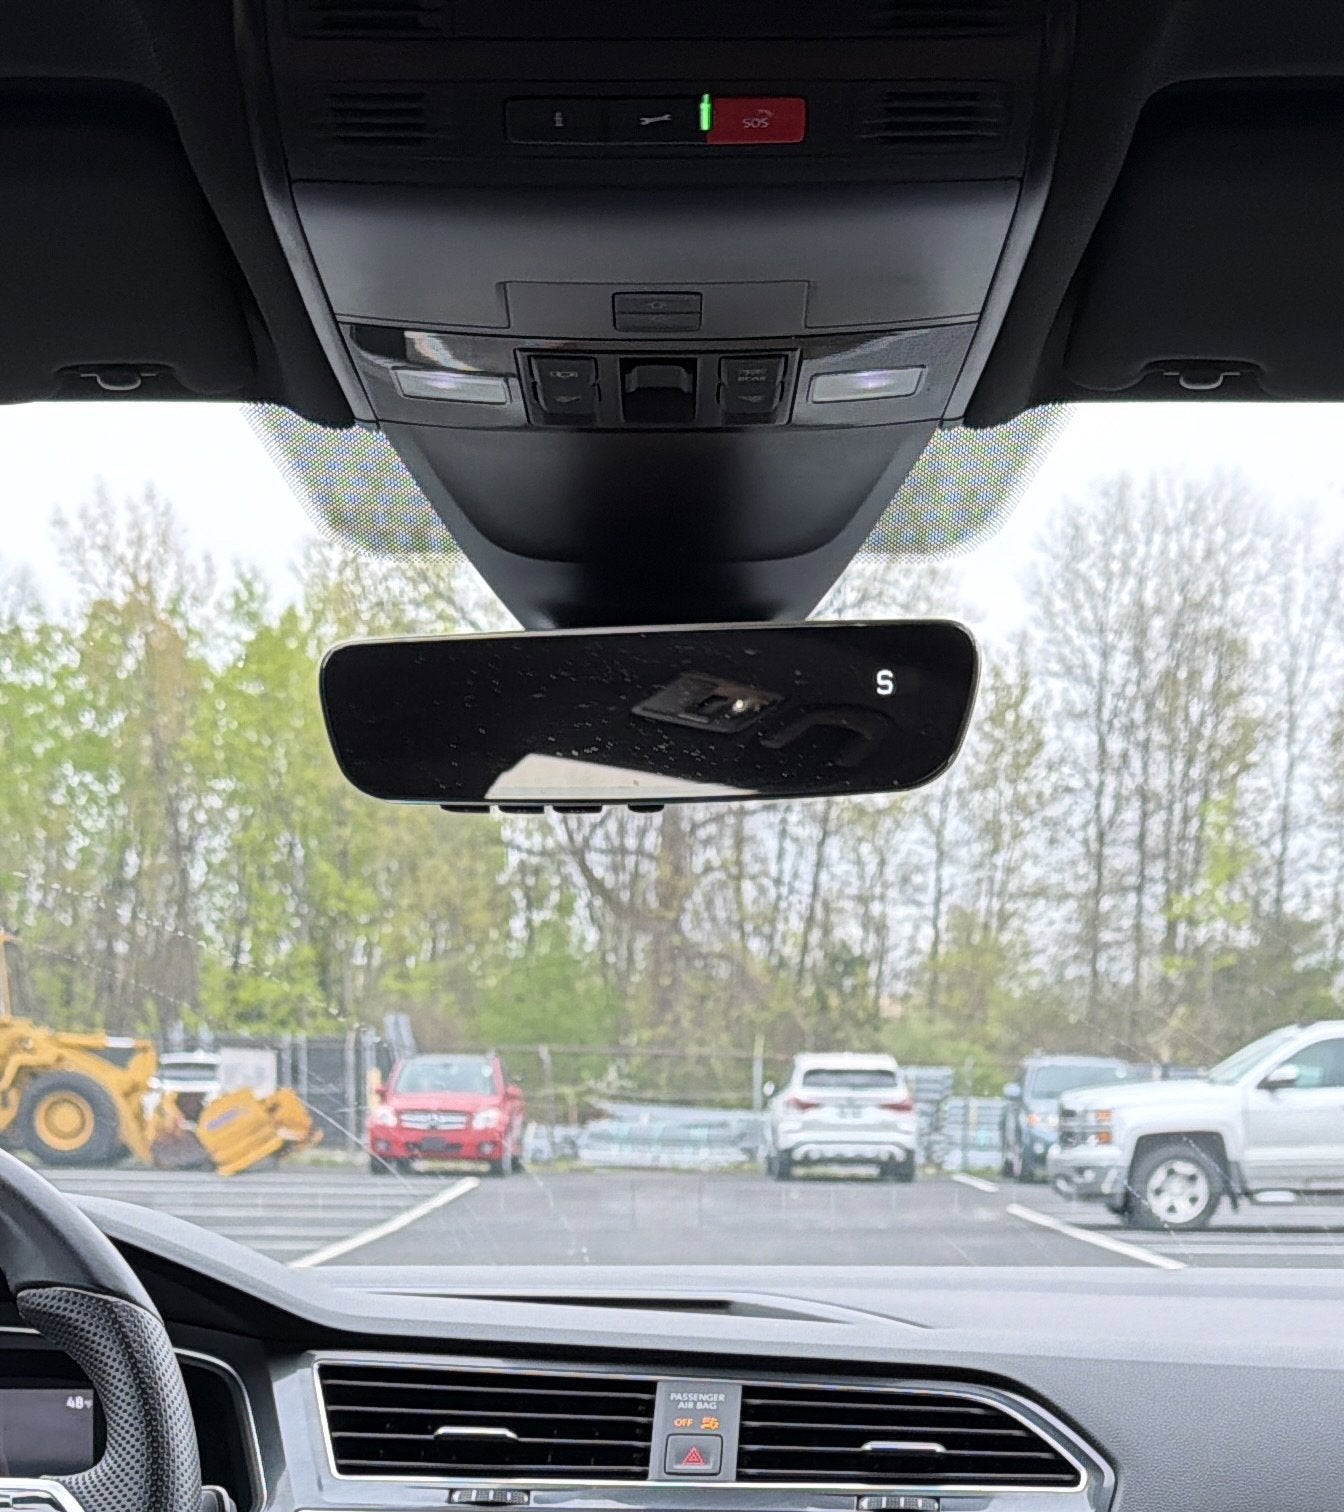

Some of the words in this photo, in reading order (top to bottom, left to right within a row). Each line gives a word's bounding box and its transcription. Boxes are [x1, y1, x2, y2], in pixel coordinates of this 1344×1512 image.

[742, 118, 769, 128] SOS
[876, 670, 894, 696] S
[670, 1392, 725, 1401] PASSENGER
[678, 1401, 693, 1409] AIR
[696, 1401, 717, 1409] BAG
[673, 1418, 693, 1427] OFF
